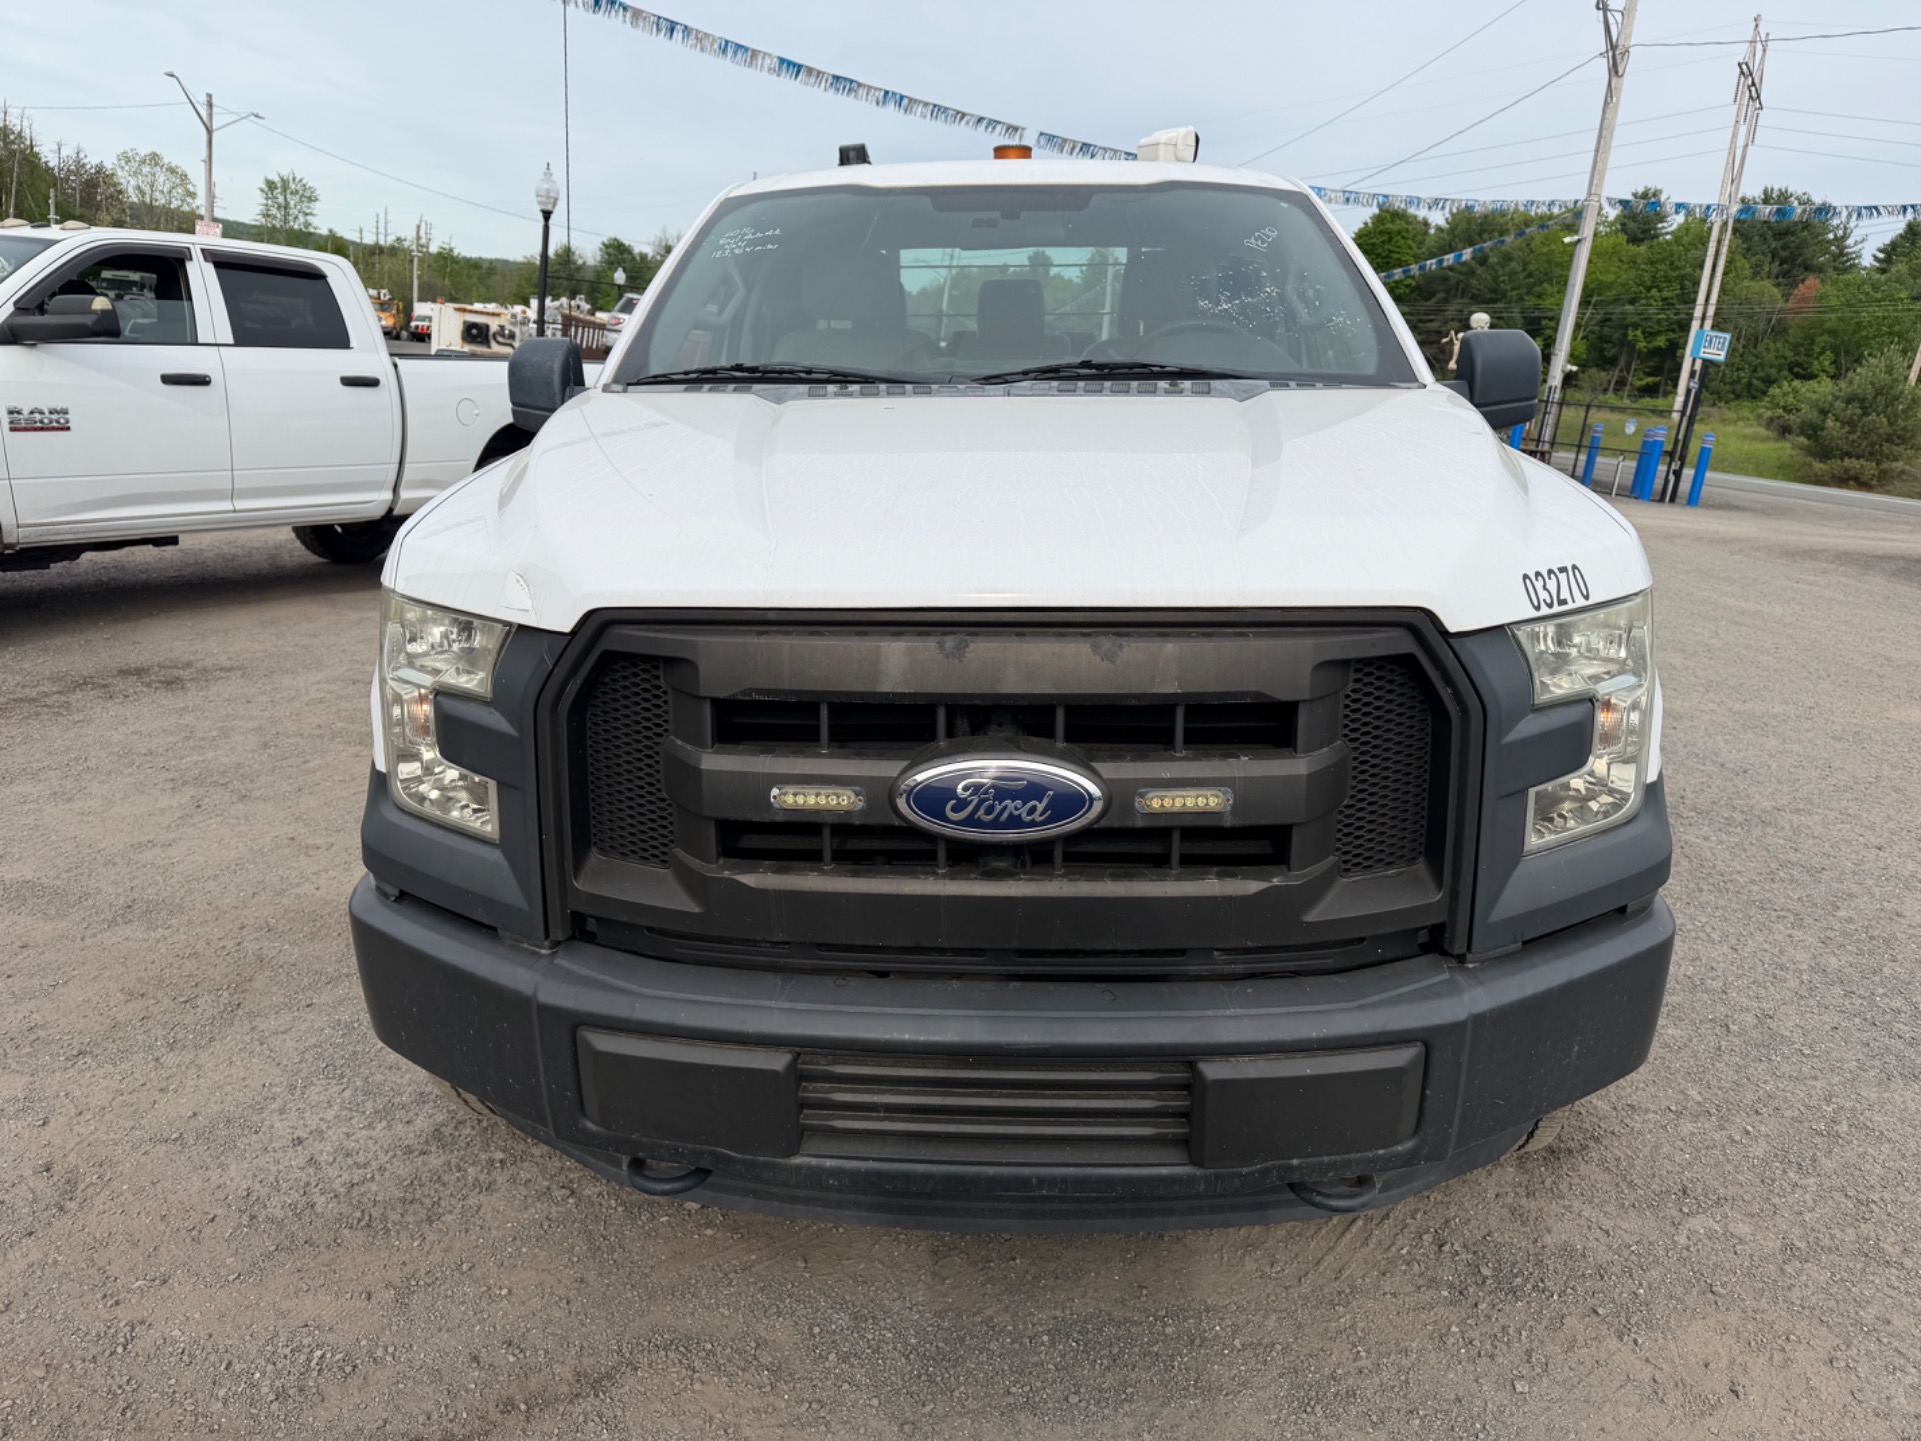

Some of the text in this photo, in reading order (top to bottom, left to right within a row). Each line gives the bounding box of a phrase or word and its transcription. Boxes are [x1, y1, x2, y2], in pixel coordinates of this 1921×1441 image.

[1702, 333, 1728, 352] ENTER
[6, 406, 70, 416] RAM
[7, 416, 70, 426] 2500
[1522, 563, 1590, 612] 03270
[945, 778, 1055, 822] Ford
